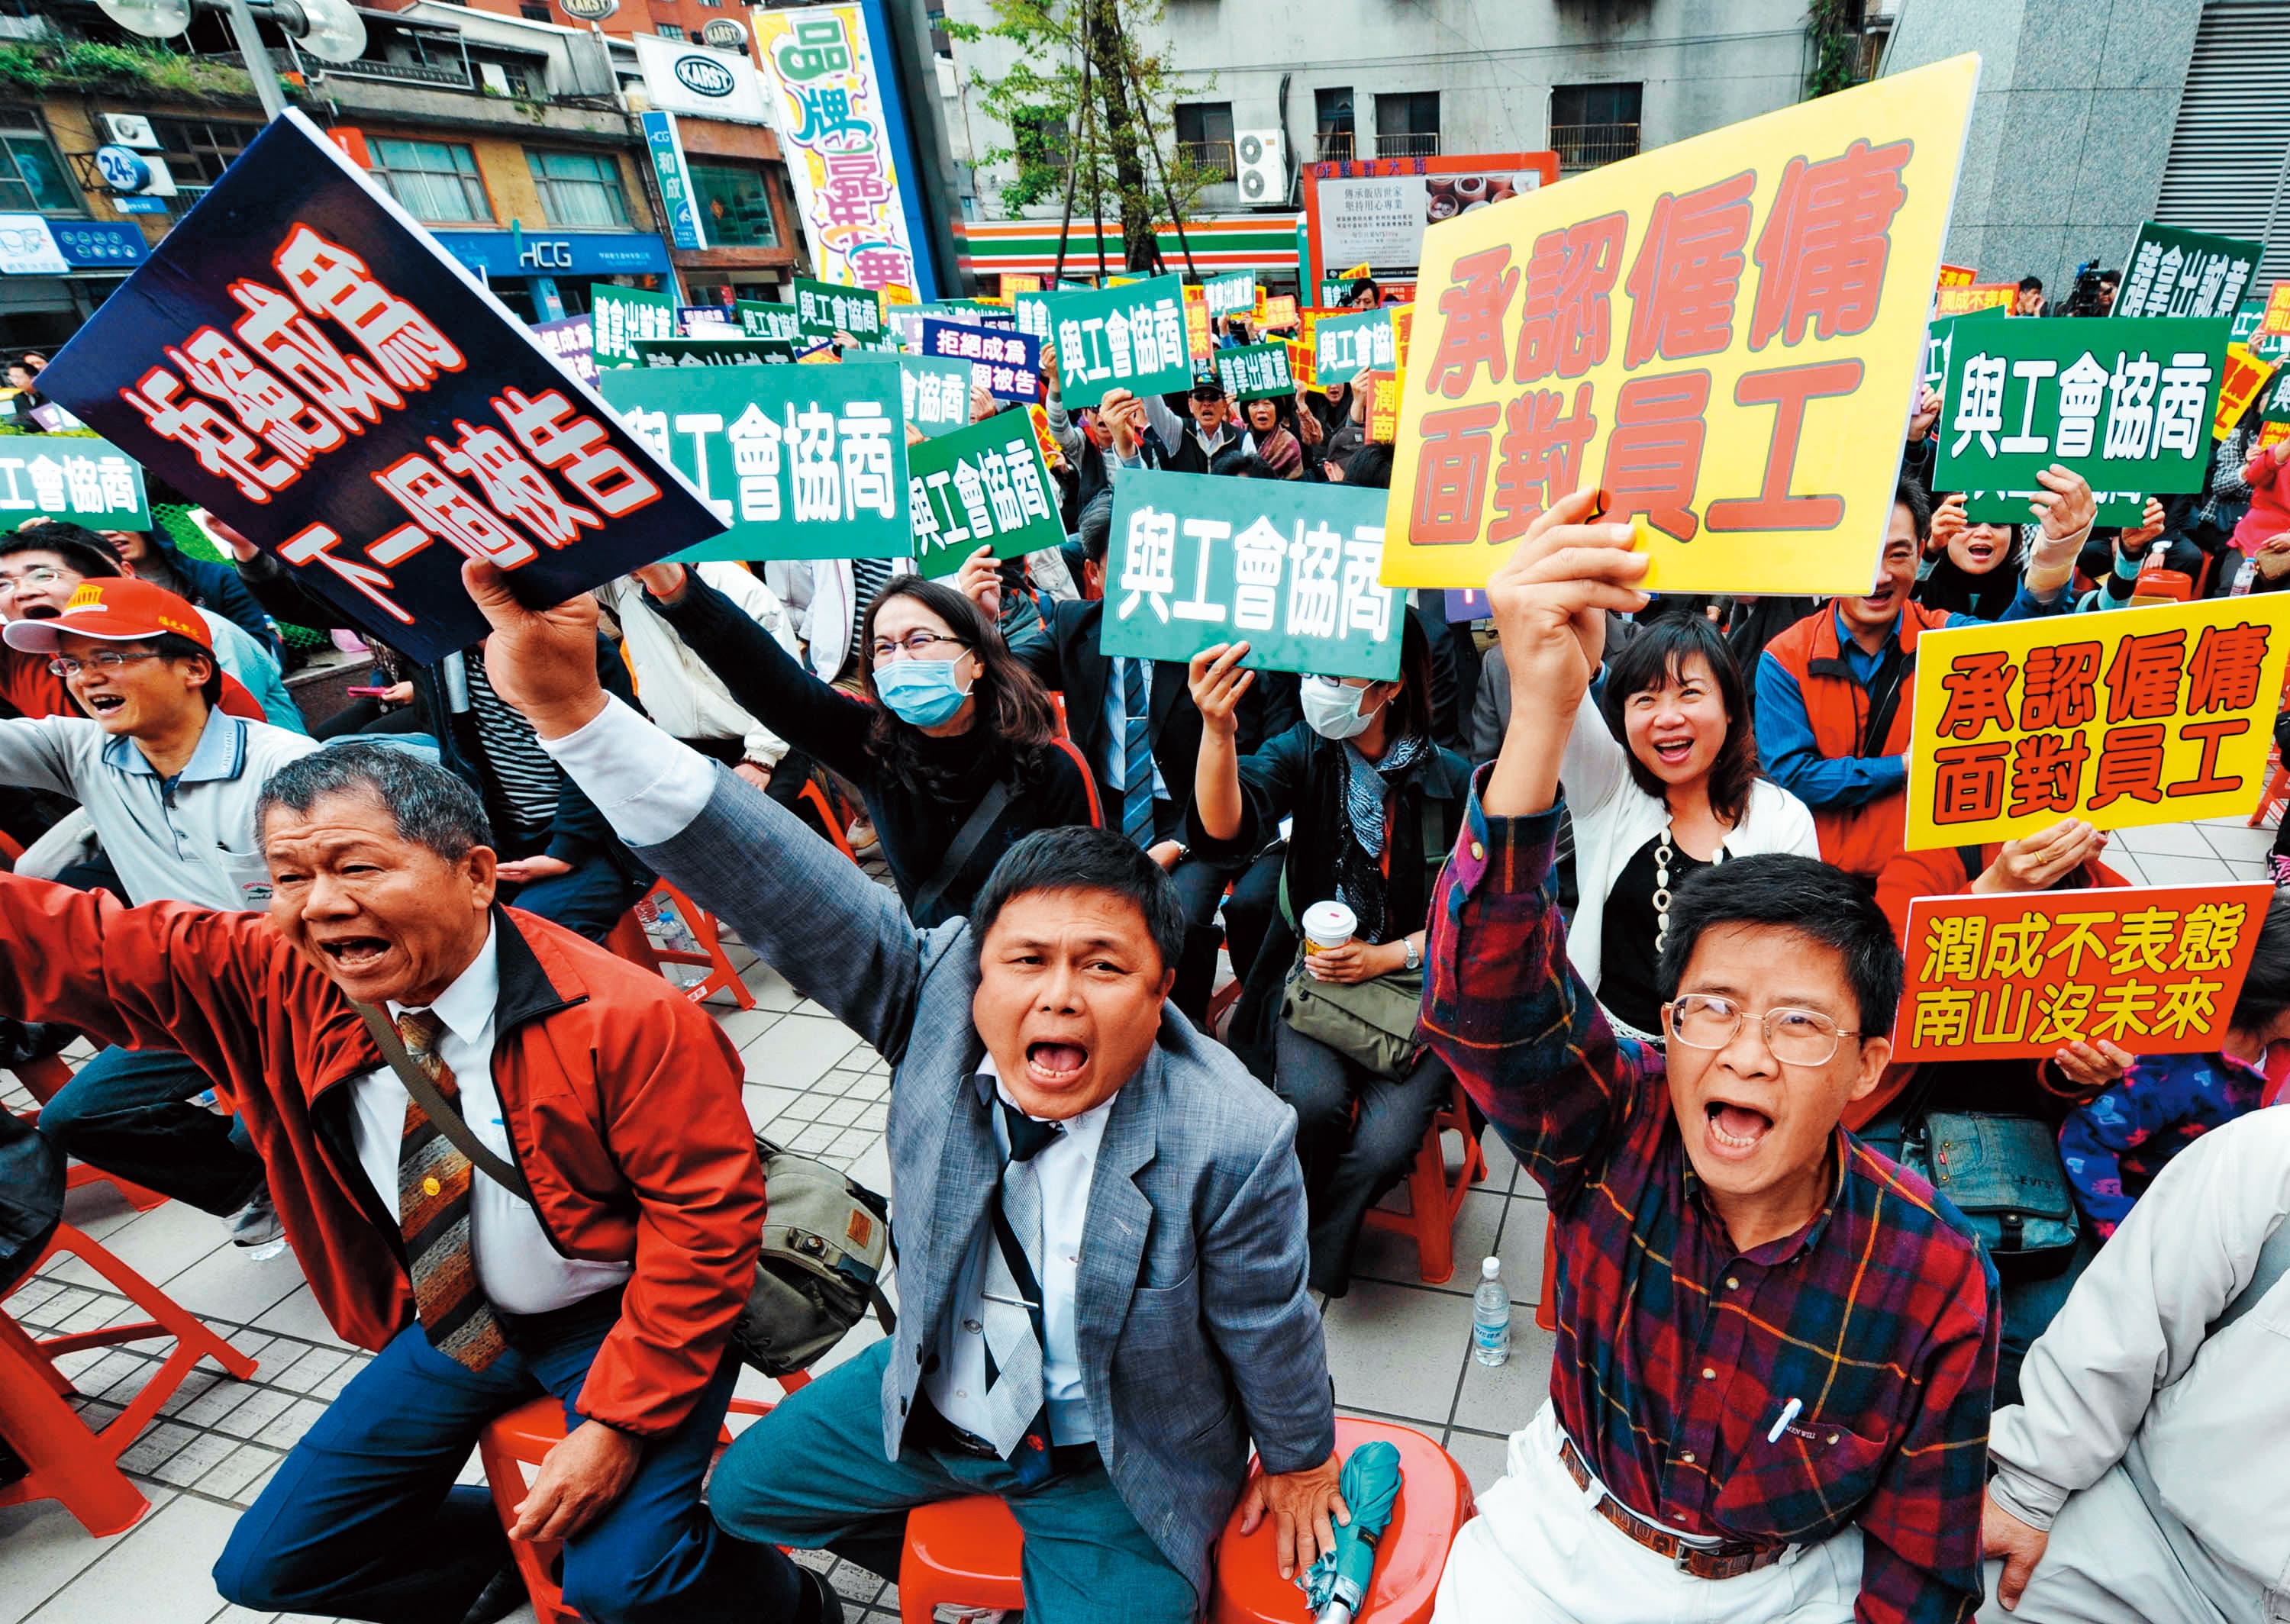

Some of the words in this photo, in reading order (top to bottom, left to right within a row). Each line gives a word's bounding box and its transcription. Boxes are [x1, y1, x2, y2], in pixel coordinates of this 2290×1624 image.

[679, 63, 731, 89] KARST
[706, 28, 737, 43] KARST
[657, 151, 682, 200] 和成
[520, 241, 572, 267] HCG
[1425, 137, 1914, 400] 承認僱傭
[2119, 240, 2251, 317] 請拿出誠意
[799, 290, 879, 334] 與工會協商
[1058, 298, 1183, 388] 與工會協商
[1319, 321, 1395, 373] 與工會協
[1218, 348, 1291, 395] 請拿出誠意
[1950, 350, 2213, 460] 與工會協商
[1408, 357, 1864, 545] 面對員工
[277, 385, 662, 624] 下一個被告
[909, 438, 1050, 557] 與工會協商
[1118, 505, 1393, 643] 與工會協商
[1936, 621, 2272, 740] 承認僱傭
[1933, 718, 2251, 826] 面對員工
[1917, 902, 2246, 984] 潤成不表態
[1910, 975, 2224, 1050] 南山沒未來
